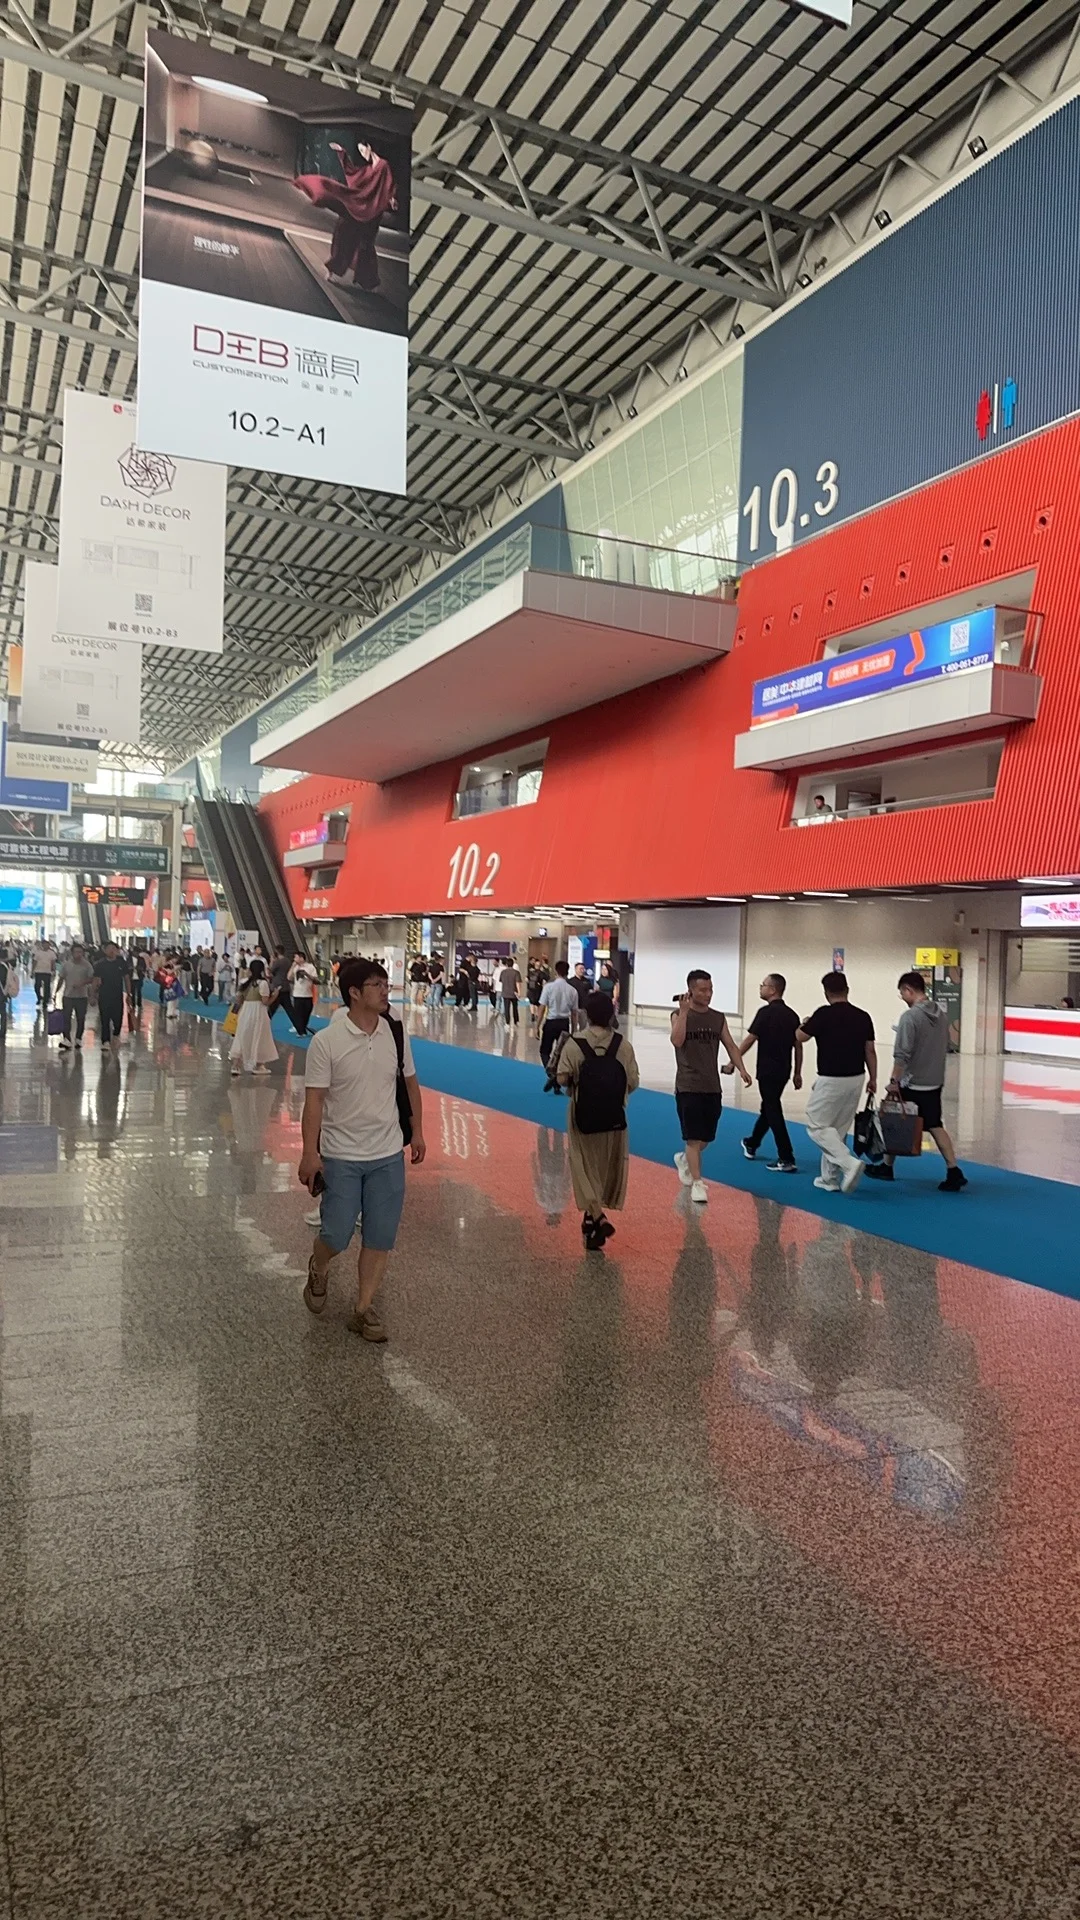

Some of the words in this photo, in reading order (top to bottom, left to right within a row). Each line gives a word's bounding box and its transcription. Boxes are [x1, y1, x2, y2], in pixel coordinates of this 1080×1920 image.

[193, 359, 289, 384] CUSTOMIZATION
[228, 410, 326, 446] 10.2-A1
[100, 495, 140, 512] DASH
[143, 502, 191, 520] DECOR
[743, 461, 839, 552] 10.3
[82, 638, 118, 651] DECOR
[446, 842, 501, 899] 10.2
